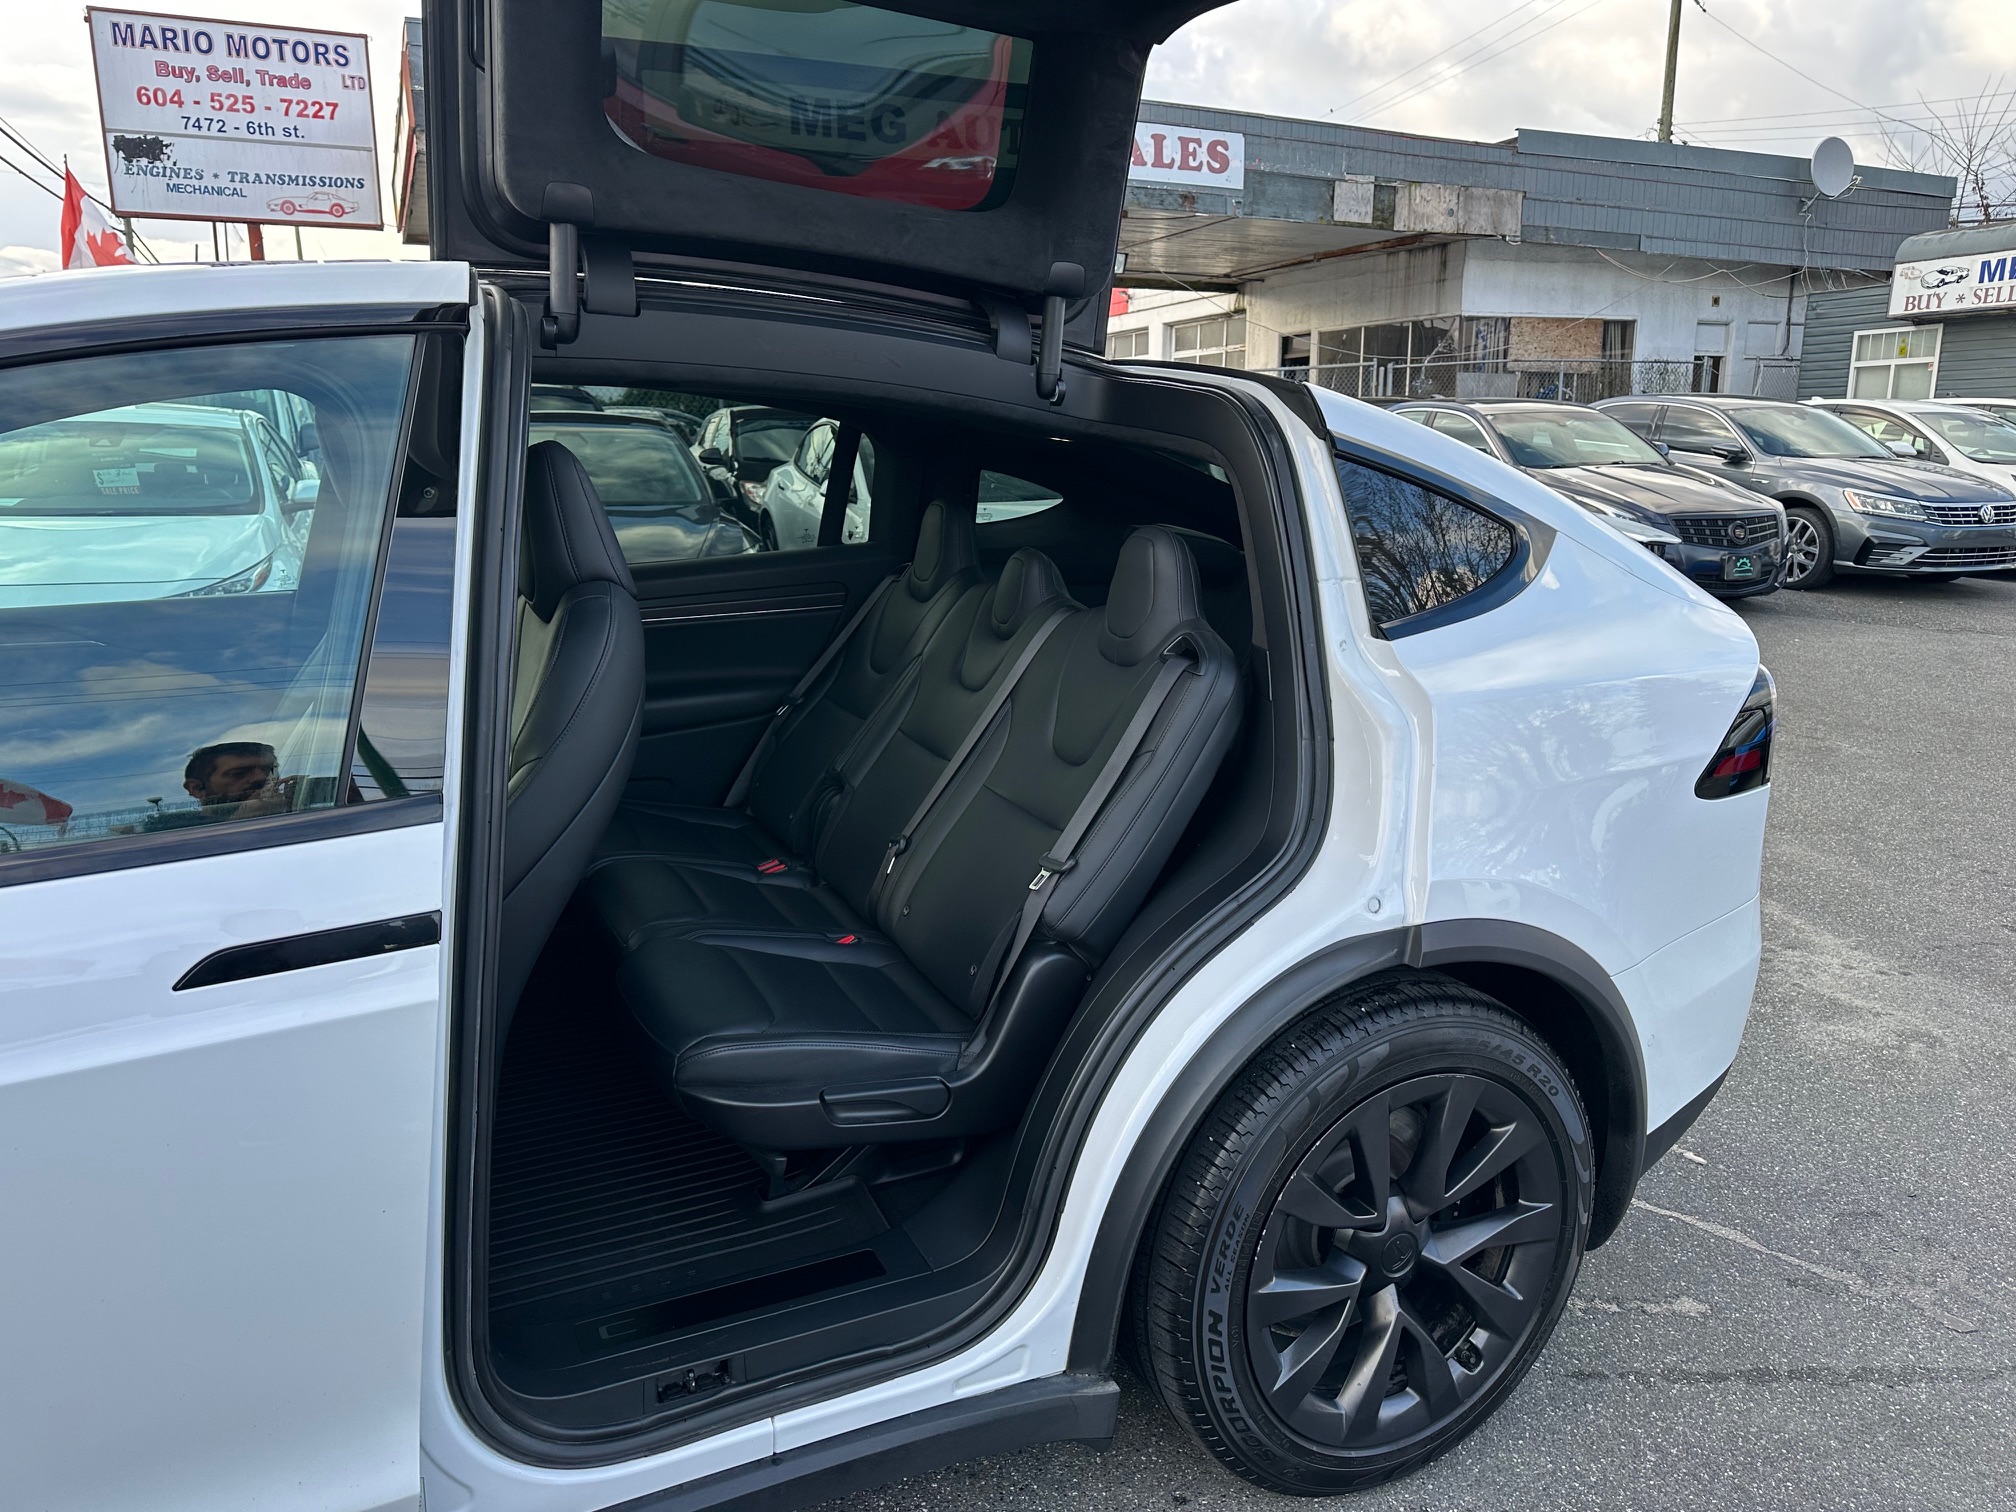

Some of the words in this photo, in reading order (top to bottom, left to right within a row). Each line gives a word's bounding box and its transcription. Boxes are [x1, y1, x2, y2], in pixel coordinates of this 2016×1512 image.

[110, 20, 215, 55] MARIO
[224, 31, 351, 68] MOTORS
[155, 60, 201, 83] Buy,
[206, 65, 251, 87] Sell,
[255, 69, 312, 90] Trade
[341, 74, 367, 90] LTD
[136, 86, 184, 108] 604
[210, 92, 256, 114] 525
[279, 97, 339, 120] 7227
[181, 116, 227, 133] 7472
[246, 121, 275, 136] 6th
[282, 124, 305, 139] st.
[789, 97, 907, 144] MEG
[123, 163, 204, 181] ENGINES
[227, 171, 366, 189] TRANSMISSIONS
[166, 183, 248, 197] MECHANICAL
[1903, 291, 1948, 312] BUY
[1971, 285, 2016, 305] SELL
[1527, 1063, 1560, 1097] R20
[1210, 1200, 1245, 1294] VERDE
[1224, 1269, 1233, 1293] ALL
[1230, 1213, 1250, 1263] SEASON
[1207, 1309, 1279, 1464] SCORPION
